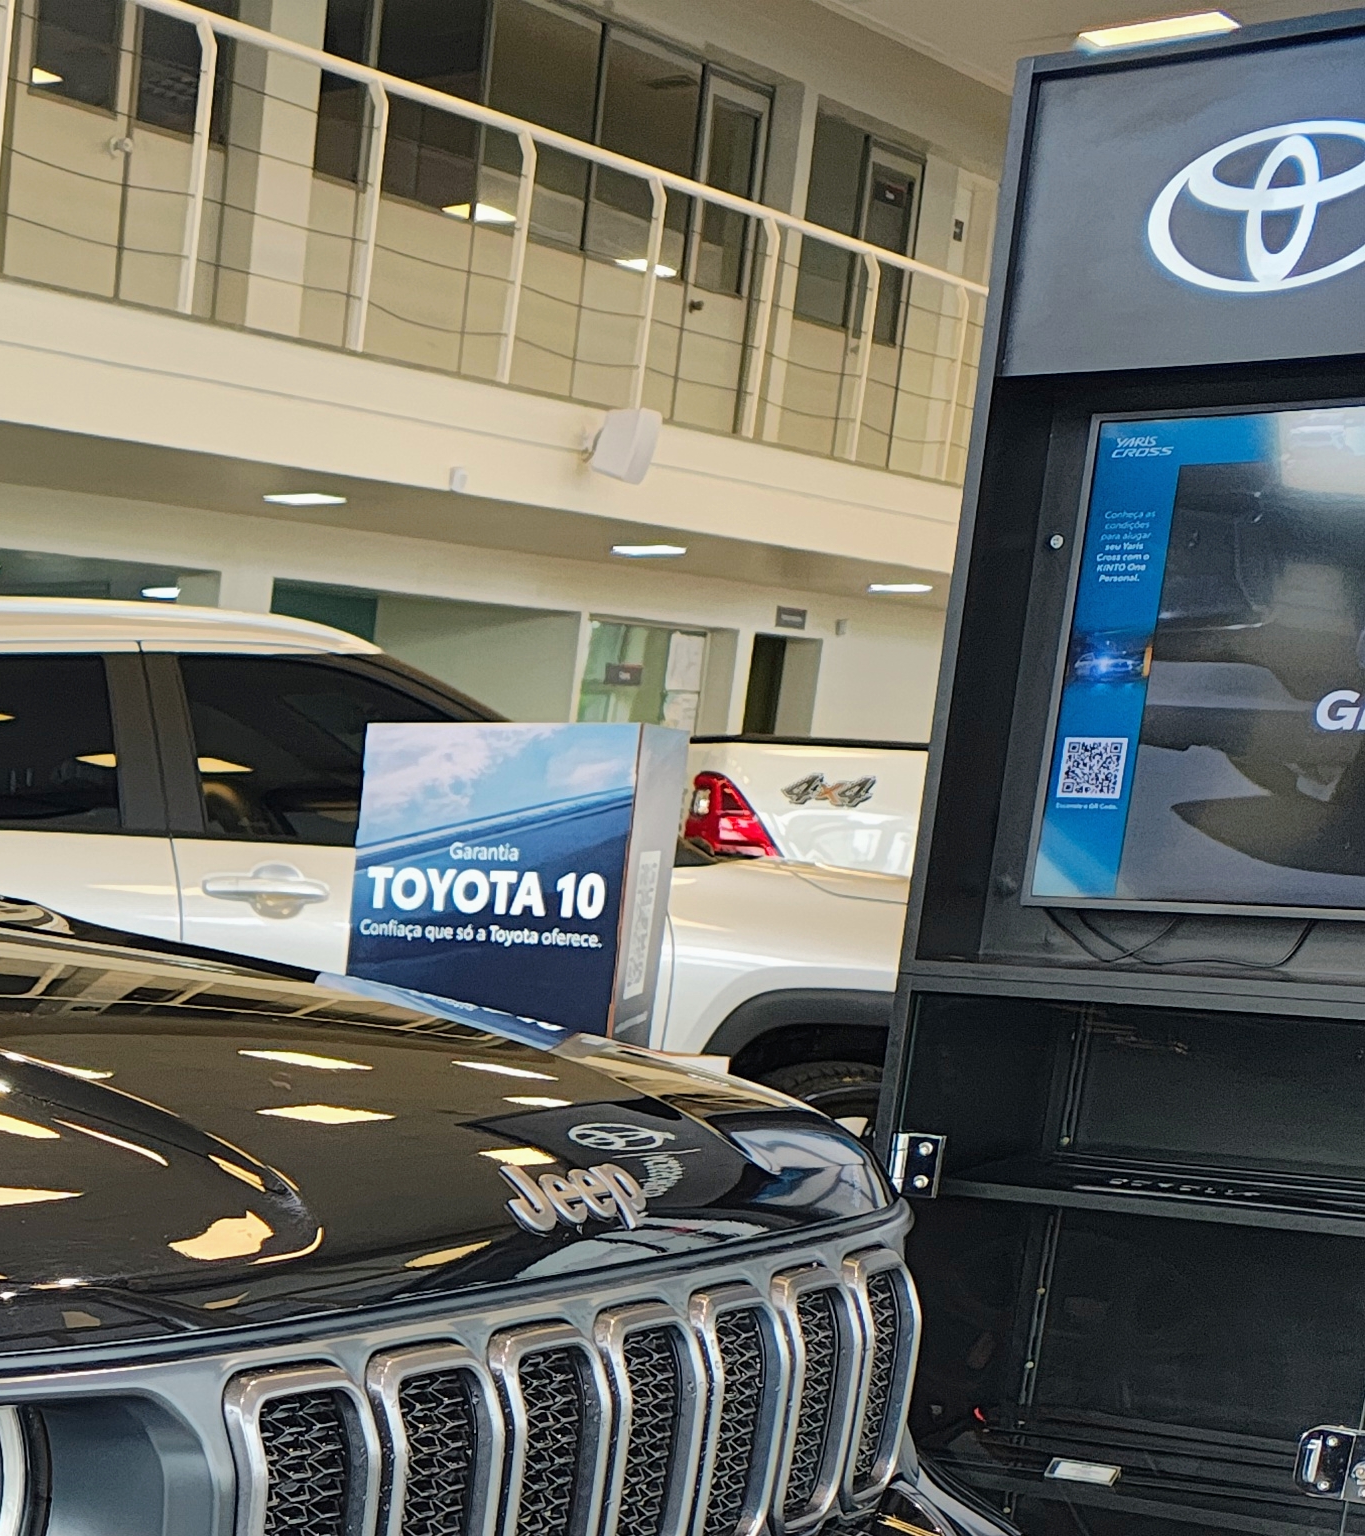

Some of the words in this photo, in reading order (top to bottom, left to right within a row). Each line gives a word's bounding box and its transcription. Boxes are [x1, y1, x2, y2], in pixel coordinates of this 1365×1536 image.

[1116, 436, 1159, 448] YARIS
[1111, 446, 1175, 459] CROSS
[1123, 541, 1144, 550] Yaris
[1096, 553, 1121, 562] Cross
[1122, 553, 1142, 561] com
[1096, 563, 1126, 572] KINTO
[449, 841, 519, 862] Garantia
[367, 865, 546, 918] TOYOTA
[556, 872, 607, 920] 10
[424, 925, 453, 942] que
[455, 923, 473, 940] só
[475, 929, 486, 941] a
[489, 924, 539, 947] Toyota
[541, 928, 603, 949] oferece.
[498, 1162, 647, 1237] Jeep
